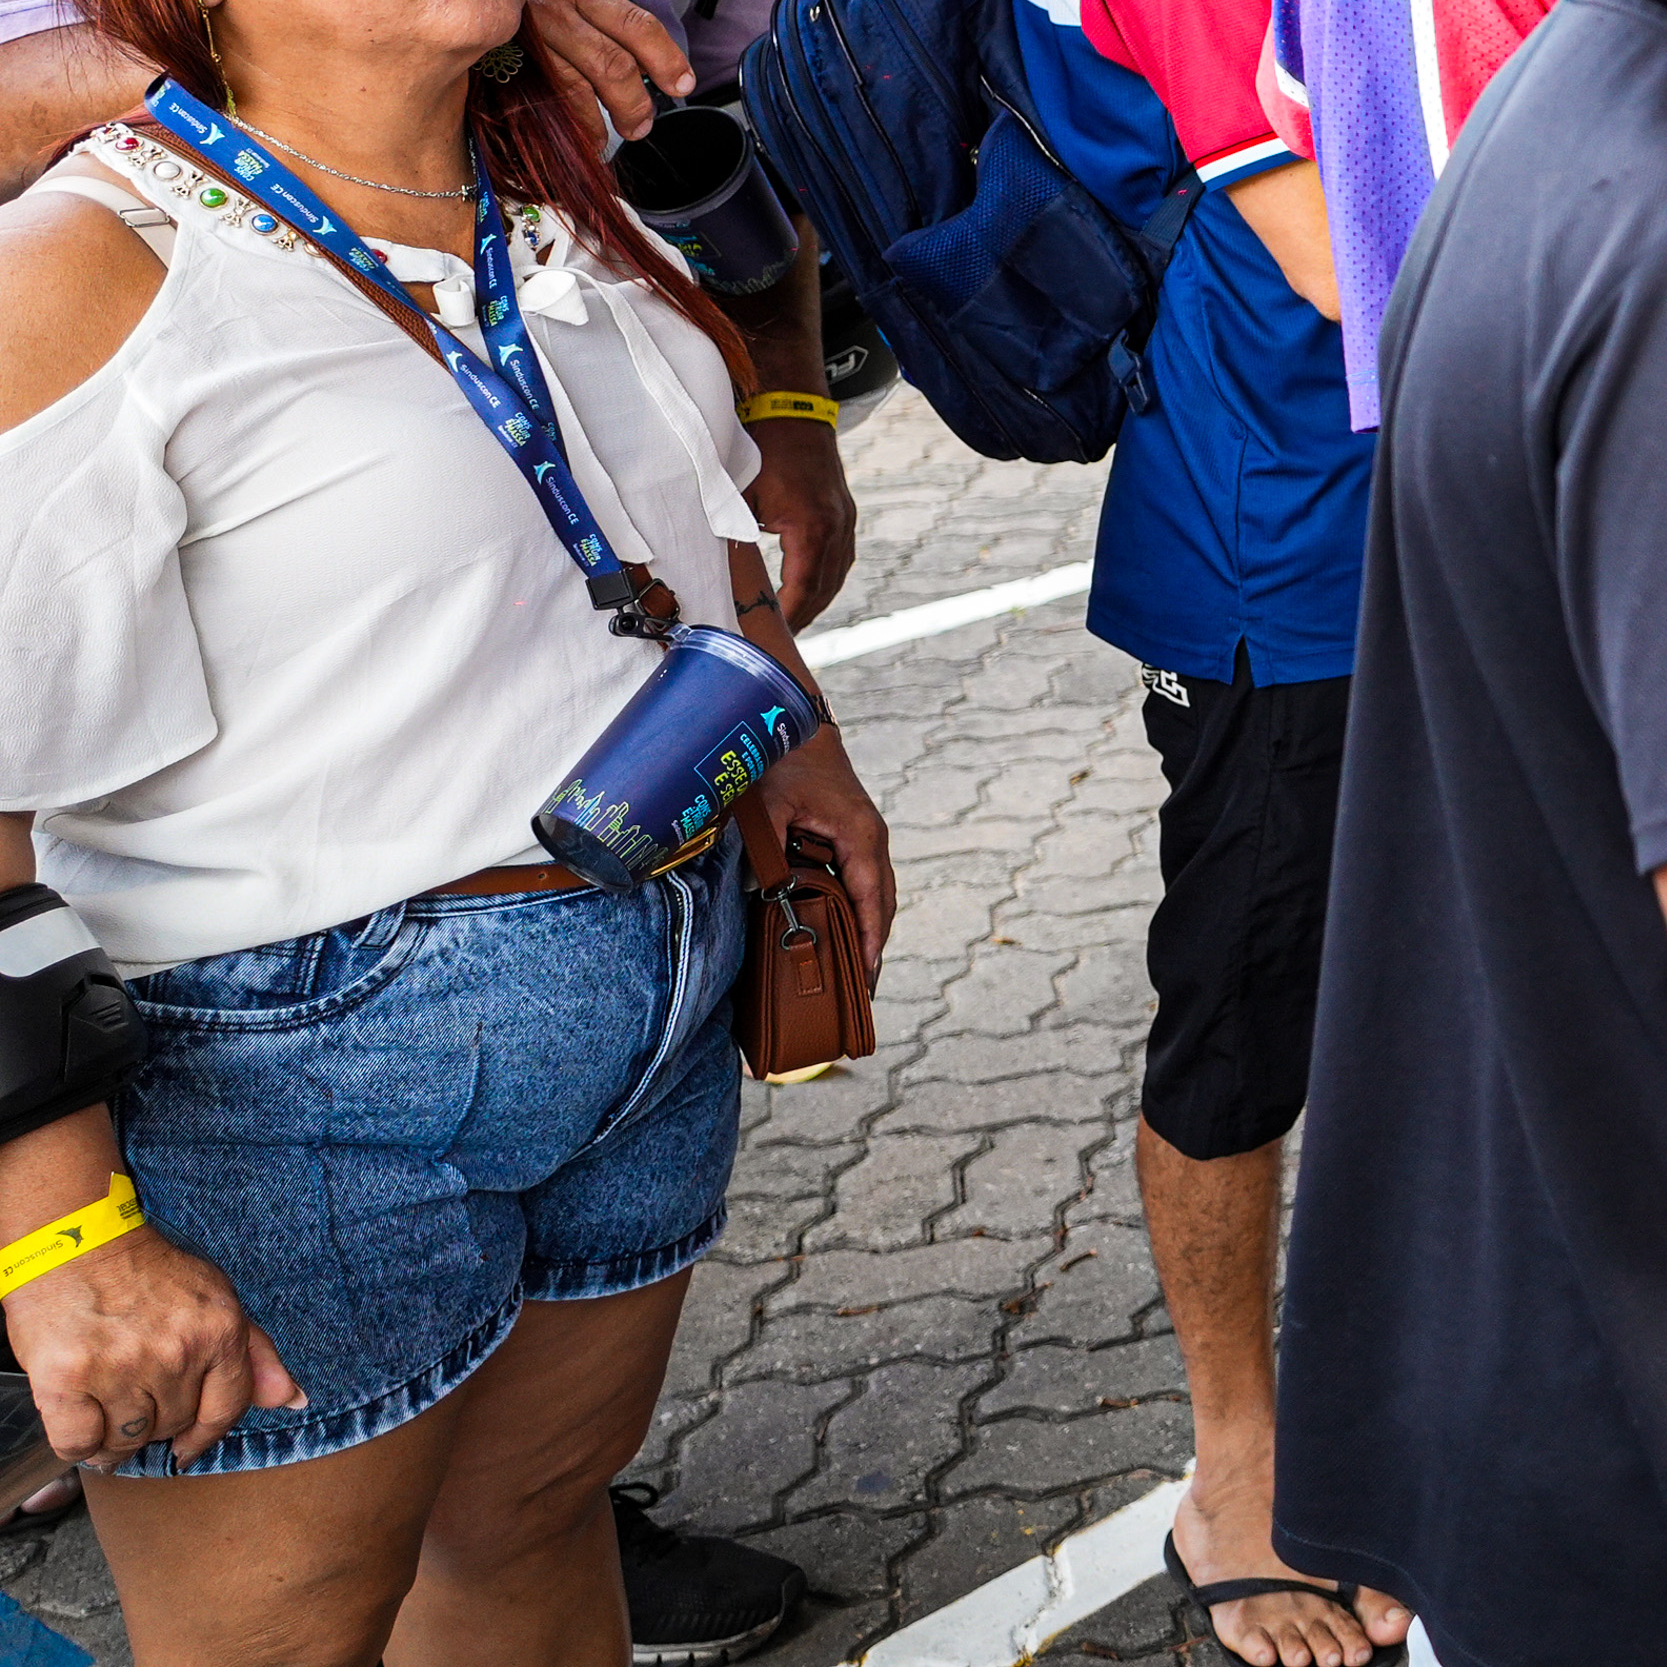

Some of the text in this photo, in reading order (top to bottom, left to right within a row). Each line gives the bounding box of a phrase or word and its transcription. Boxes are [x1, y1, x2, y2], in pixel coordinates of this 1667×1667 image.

[169, 102, 180, 113] CE
[270, 183, 319, 223] Sinduscon CE
[460, 364, 501, 408] Sinduscon CE
[510, 359, 539, 409] Sinduscon CE
[504, 421, 526, 446] MASSA
[514, 412, 531, 429] CONS
[546, 476, 579, 525] Sinduscon CE
[580, 543, 597, 566] MASSA
[589, 534, 602, 552] CONS
[740, 733, 761, 762] CELEBRA
[720, 750, 747, 785] ESSE
[694, 794, 711, 817] CONS
[3, 1239, 64, 1277] Sinduscon CE
